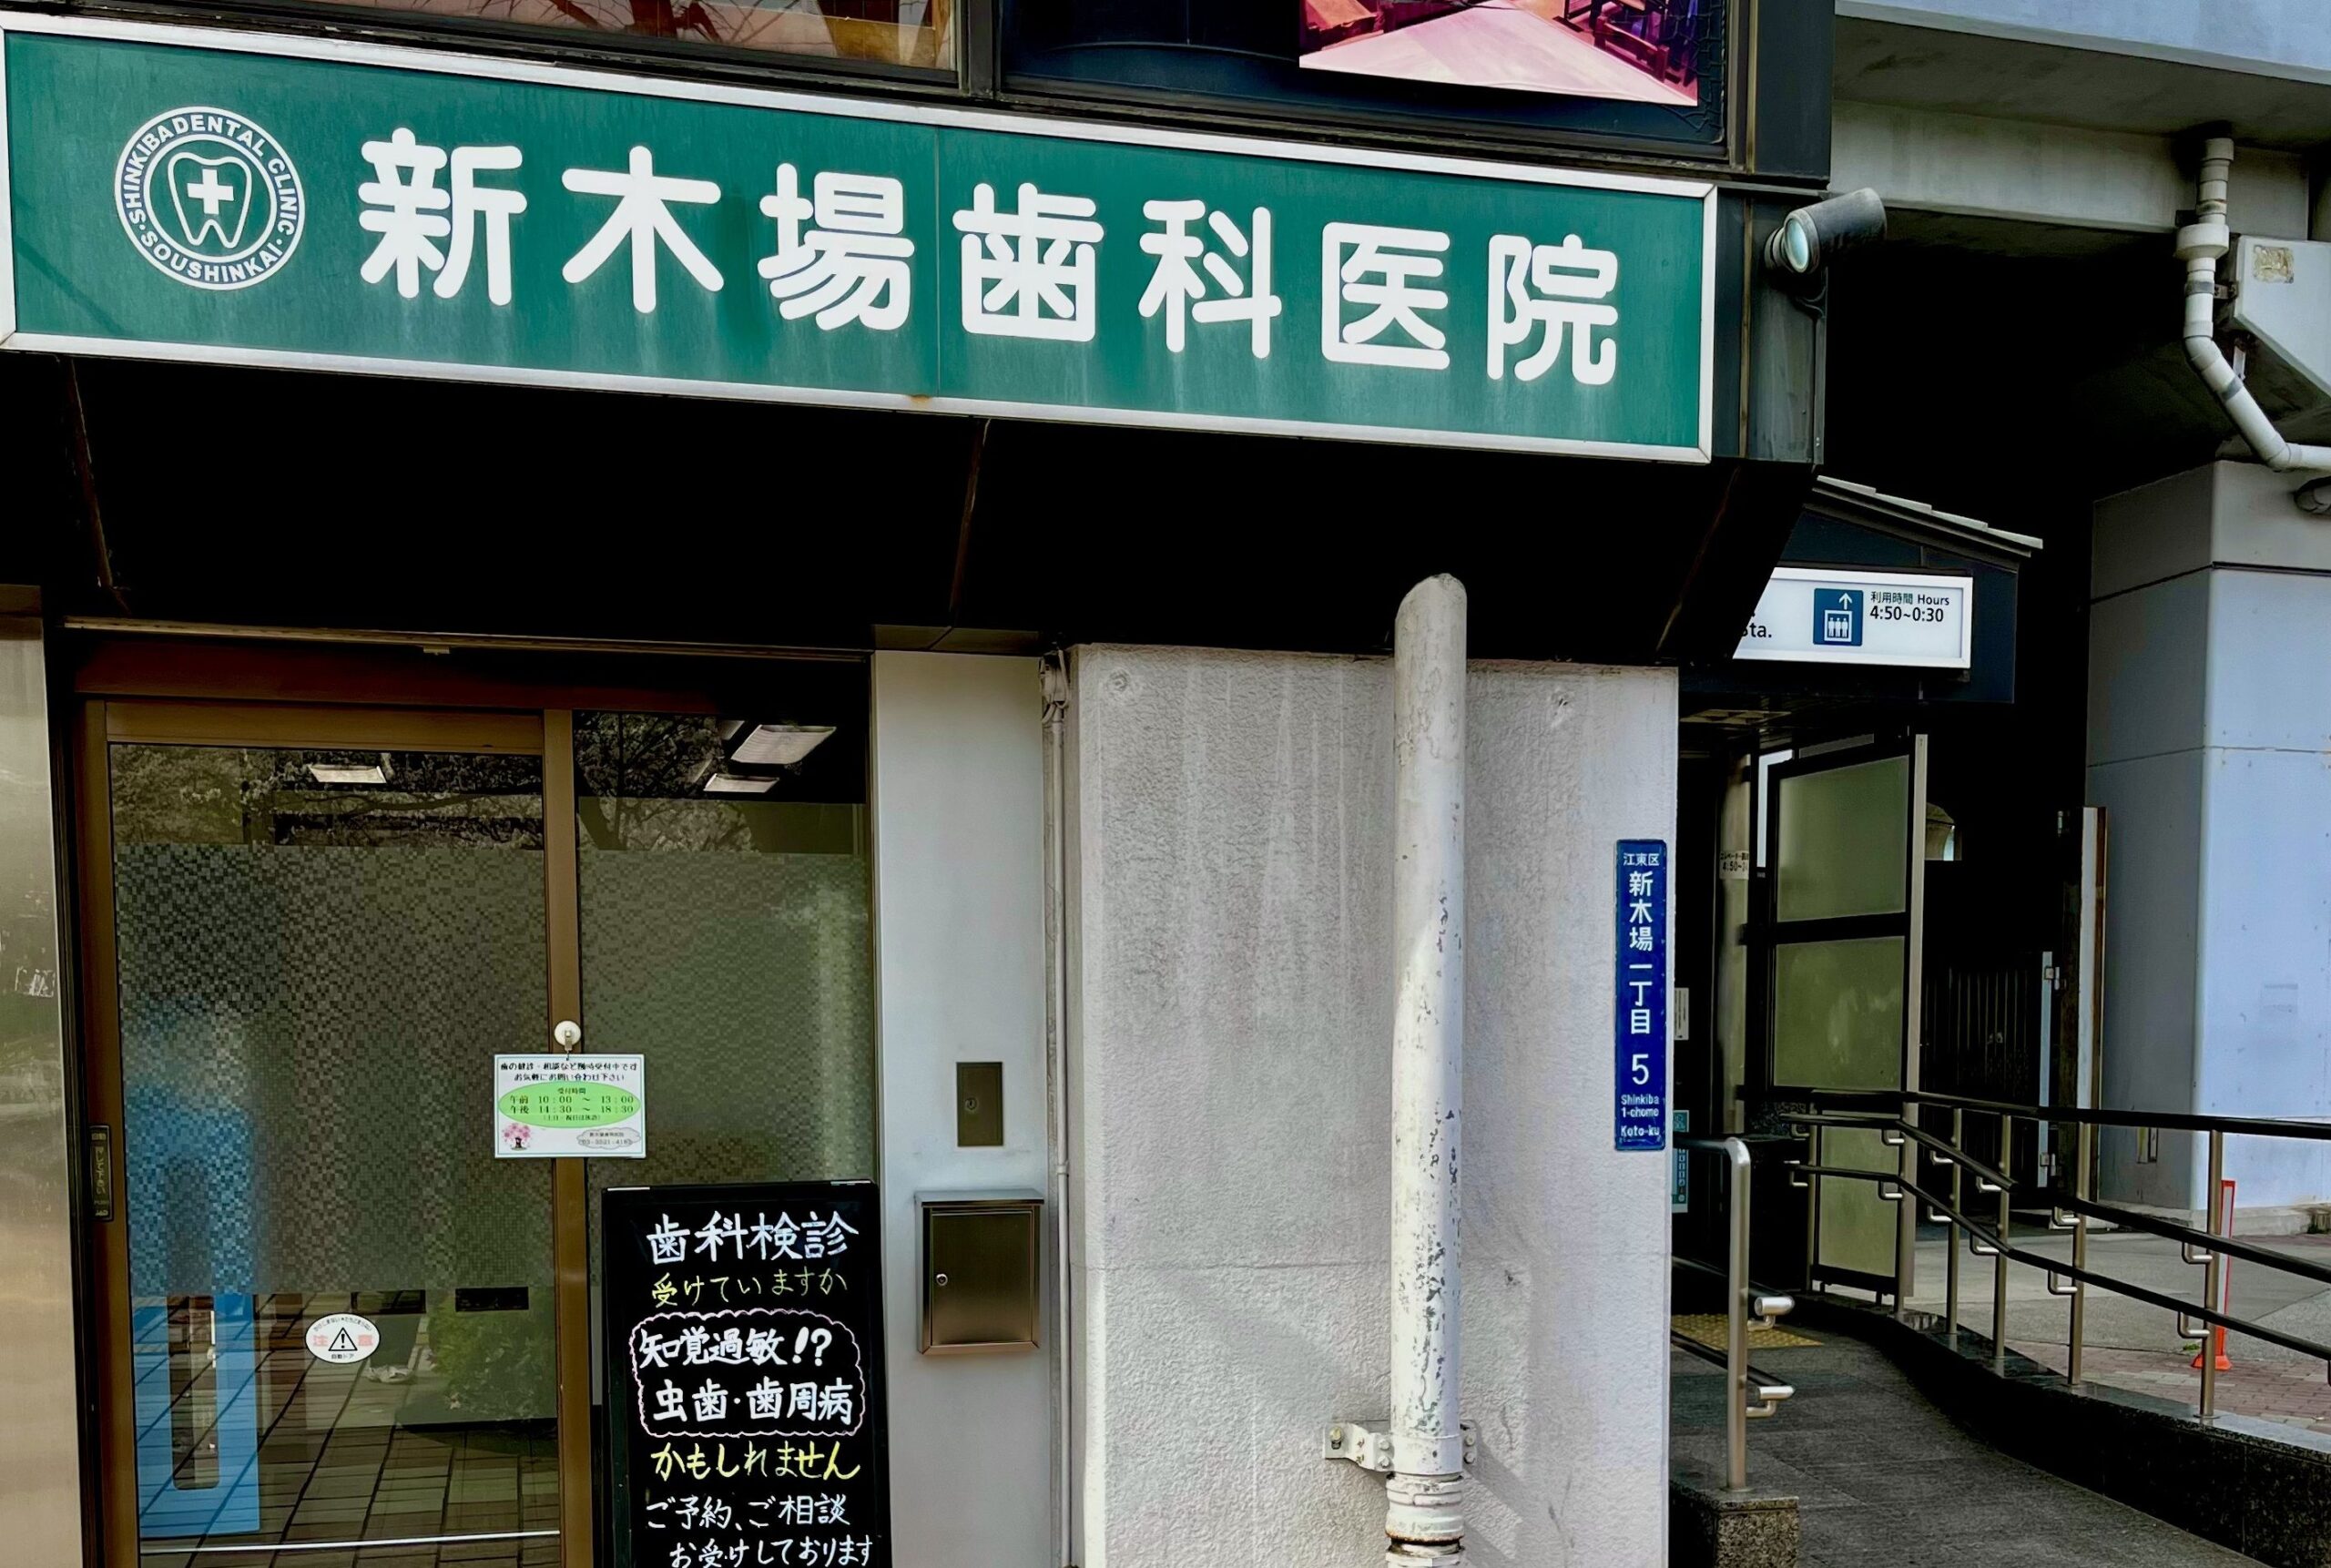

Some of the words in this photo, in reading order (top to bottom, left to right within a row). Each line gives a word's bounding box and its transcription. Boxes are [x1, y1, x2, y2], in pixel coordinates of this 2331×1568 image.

[269, 158, 298, 236] CLINIC
[140, 230, 283, 282] SOUSHINKAI
[358, 127, 1619, 386] 新木場歯科医院
[1870, 591, 1913, 605] 利用時間
[1918, 594, 1949, 606] Hours
[1624, 852, 1659, 866] 江東区
[1632, 1054, 1649, 1084] 5
[510, 1095, 529, 1105] 午前
[511, 1105, 529, 1115] 午後
[1621, 1094, 1660, 1105] Shinkiba
[1621, 1107, 1660, 1118] 1-chome
[646, 1210, 860, 1265] 歯科検診
[651, 1266, 848, 1308] 受けていますか
[653, 1375, 854, 1425] 虫歯・歯周病
[650, 1440, 861, 1481] かもしれません
[646, 1493, 850, 1531] ご予約、ご相談
[669, 1533, 873, 1568] お受けしております
